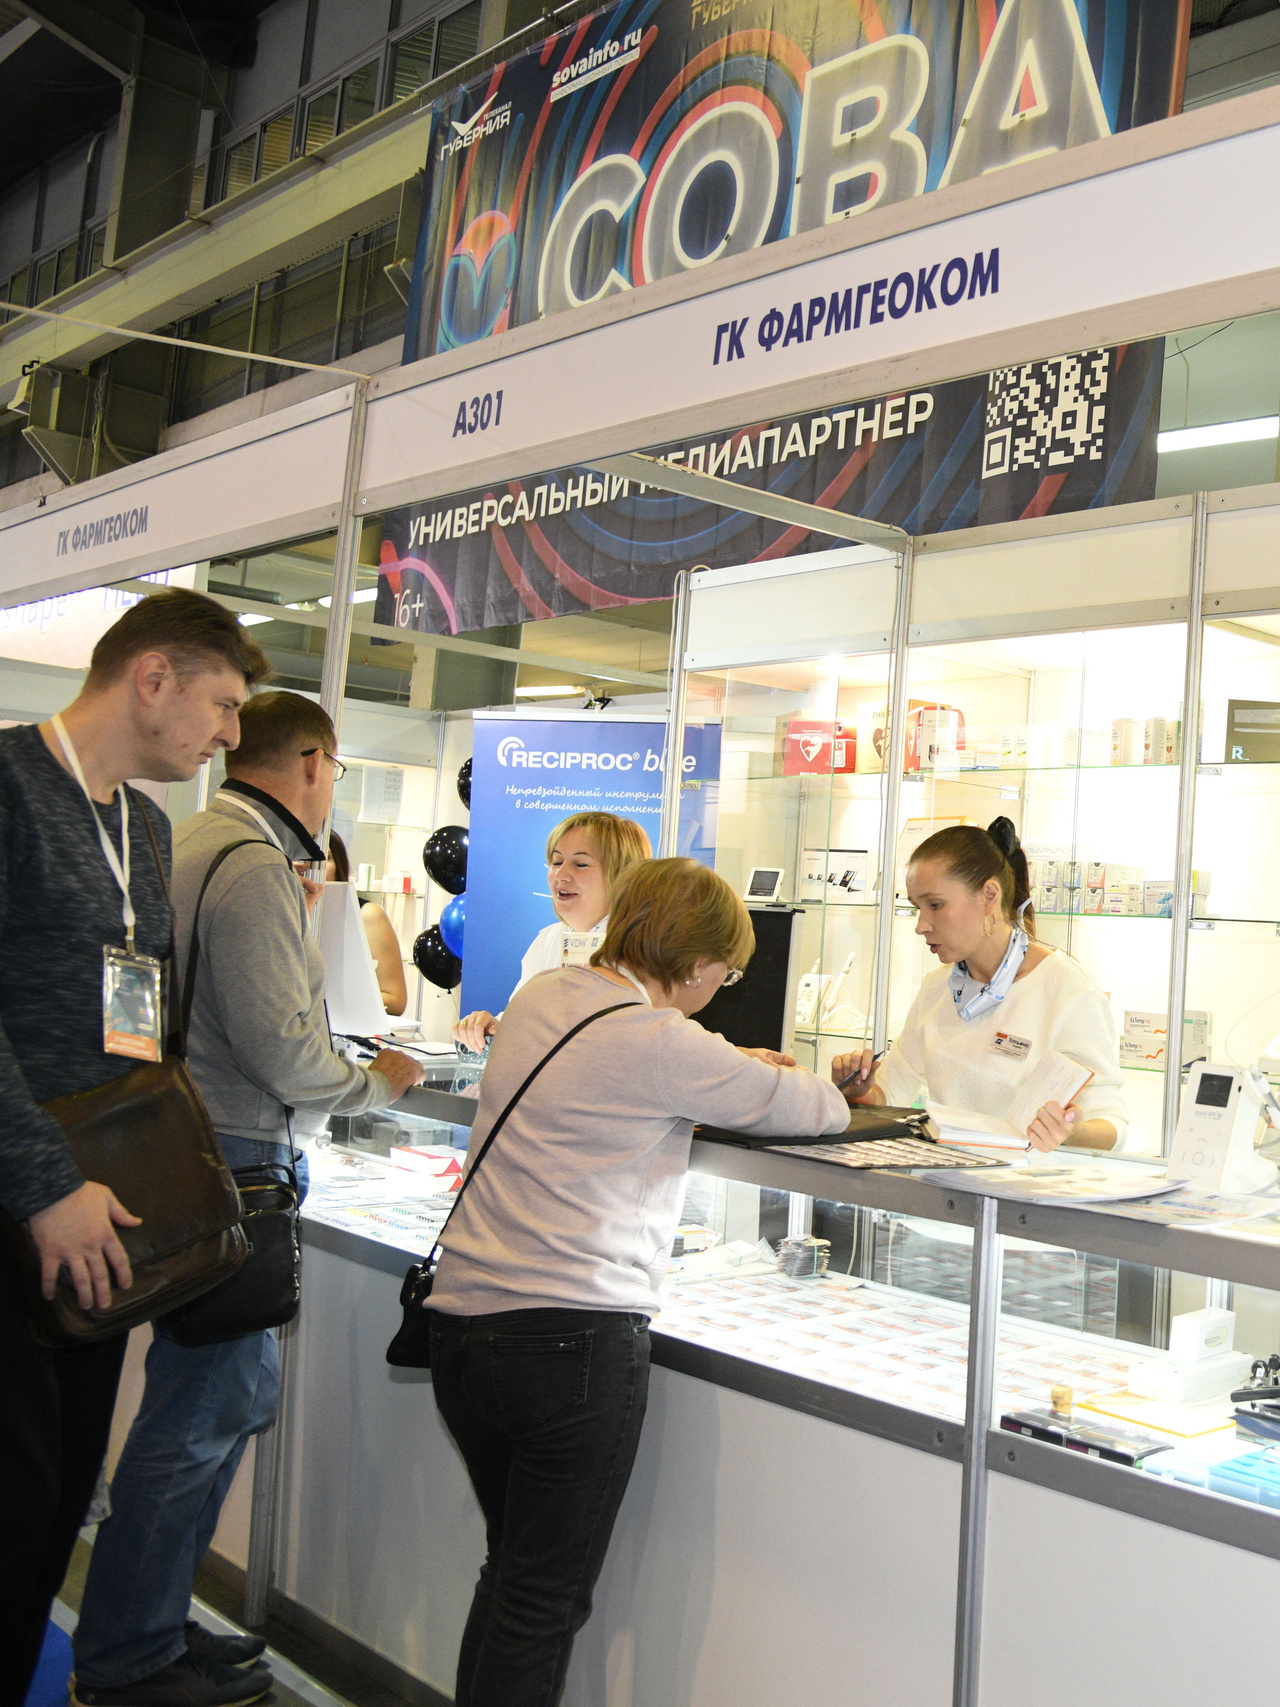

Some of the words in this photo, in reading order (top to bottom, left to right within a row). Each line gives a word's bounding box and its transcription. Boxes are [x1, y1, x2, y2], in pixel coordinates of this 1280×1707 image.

[551, 28, 642, 88] sovainfo.ru
[440, 110, 511, 161] ГУБЕРНИЯ
[483, 101, 512, 122] ТЕЛЕКАНАЛ
[538, 0, 1111, 319] СОВА
[713, 306, 750, 366] ГК
[757, 247, 1000, 353] ФАРМГЕОКОМ
[56, 530, 69, 558] ГК
[72, 506, 149, 553] ФАРМГЕОКОМ
[407, 473, 630, 550] УНИВЕРСАЛЬНЫЙ
[393, 588, 424, 629] 16+
[643, 749, 697, 772] ble
[505, 785, 603, 799] Непревзойденный
[605, 790, 685, 801] инструме
[524, 800, 600, 812] совершенном
[602, 804, 666, 814] исполнени
